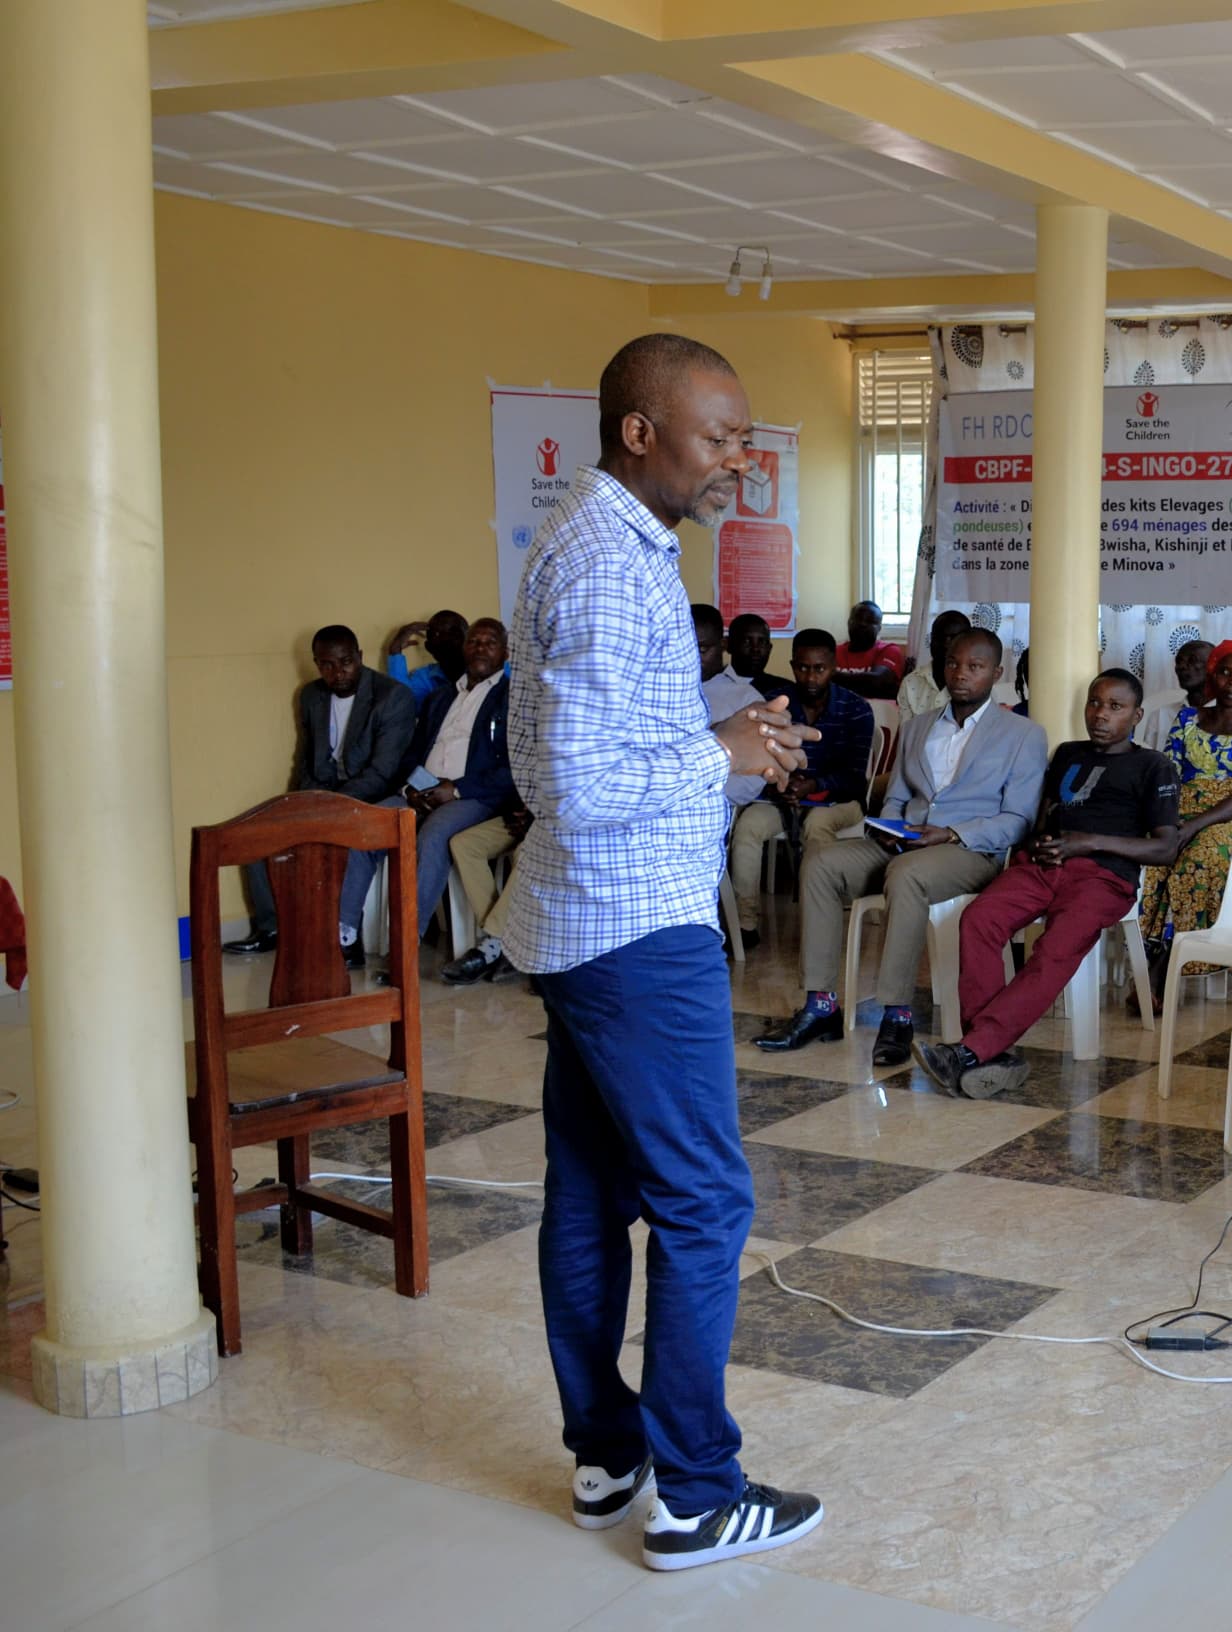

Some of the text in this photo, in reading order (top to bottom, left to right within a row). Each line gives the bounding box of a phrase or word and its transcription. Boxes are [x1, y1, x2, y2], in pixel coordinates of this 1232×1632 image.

[962, 413, 1032, 440] FH RDC
[1125, 418, 1170, 429] Save the
[1125, 430, 1170, 441] Children
[531, 478, 570, 490] Save the
[953, 499, 999, 513] Activité
[1101, 498, 1126, 512] des
[1130, 498, 1156, 512] kits
[1160, 498, 1224, 515] Elevages
[952, 518, 1024, 535] pondeuses)
[1112, 518, 1139, 532] 694
[1143, 518, 1207, 535] ménages
[952, 538, 969, 551] de
[971, 538, 1004, 551] santé
[1007, 538, 1023, 551] de
[1155, 537, 1208, 555] Kishinji
[1212, 539, 1226, 552] et
[952, 557, 1029, 570] dans la zone
[1112, 557, 1164, 572] Minova
